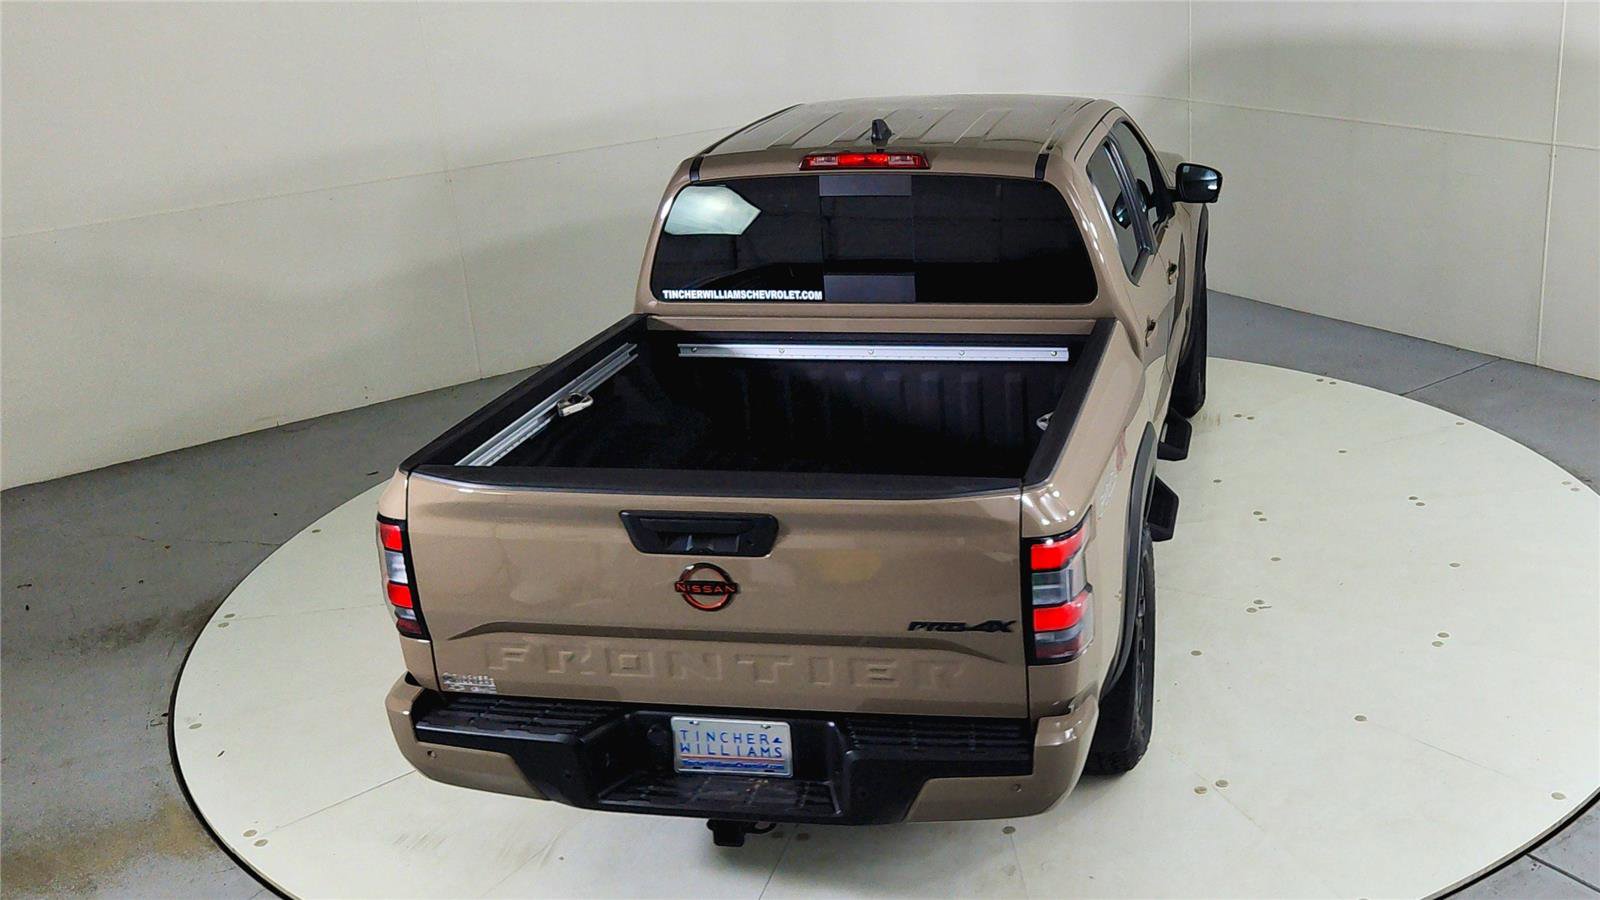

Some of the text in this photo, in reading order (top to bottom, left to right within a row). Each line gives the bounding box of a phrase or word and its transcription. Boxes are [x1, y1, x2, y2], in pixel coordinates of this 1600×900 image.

[662, 289, 823, 301] TINCHERWILLIAMSCHEVROLET.COM
[675, 581, 737, 594] NISSAN
[486, 642, 967, 691] FRONTIER
[679, 729, 770, 745] TINCHER
[680, 742, 783, 759] WILLIAMS
